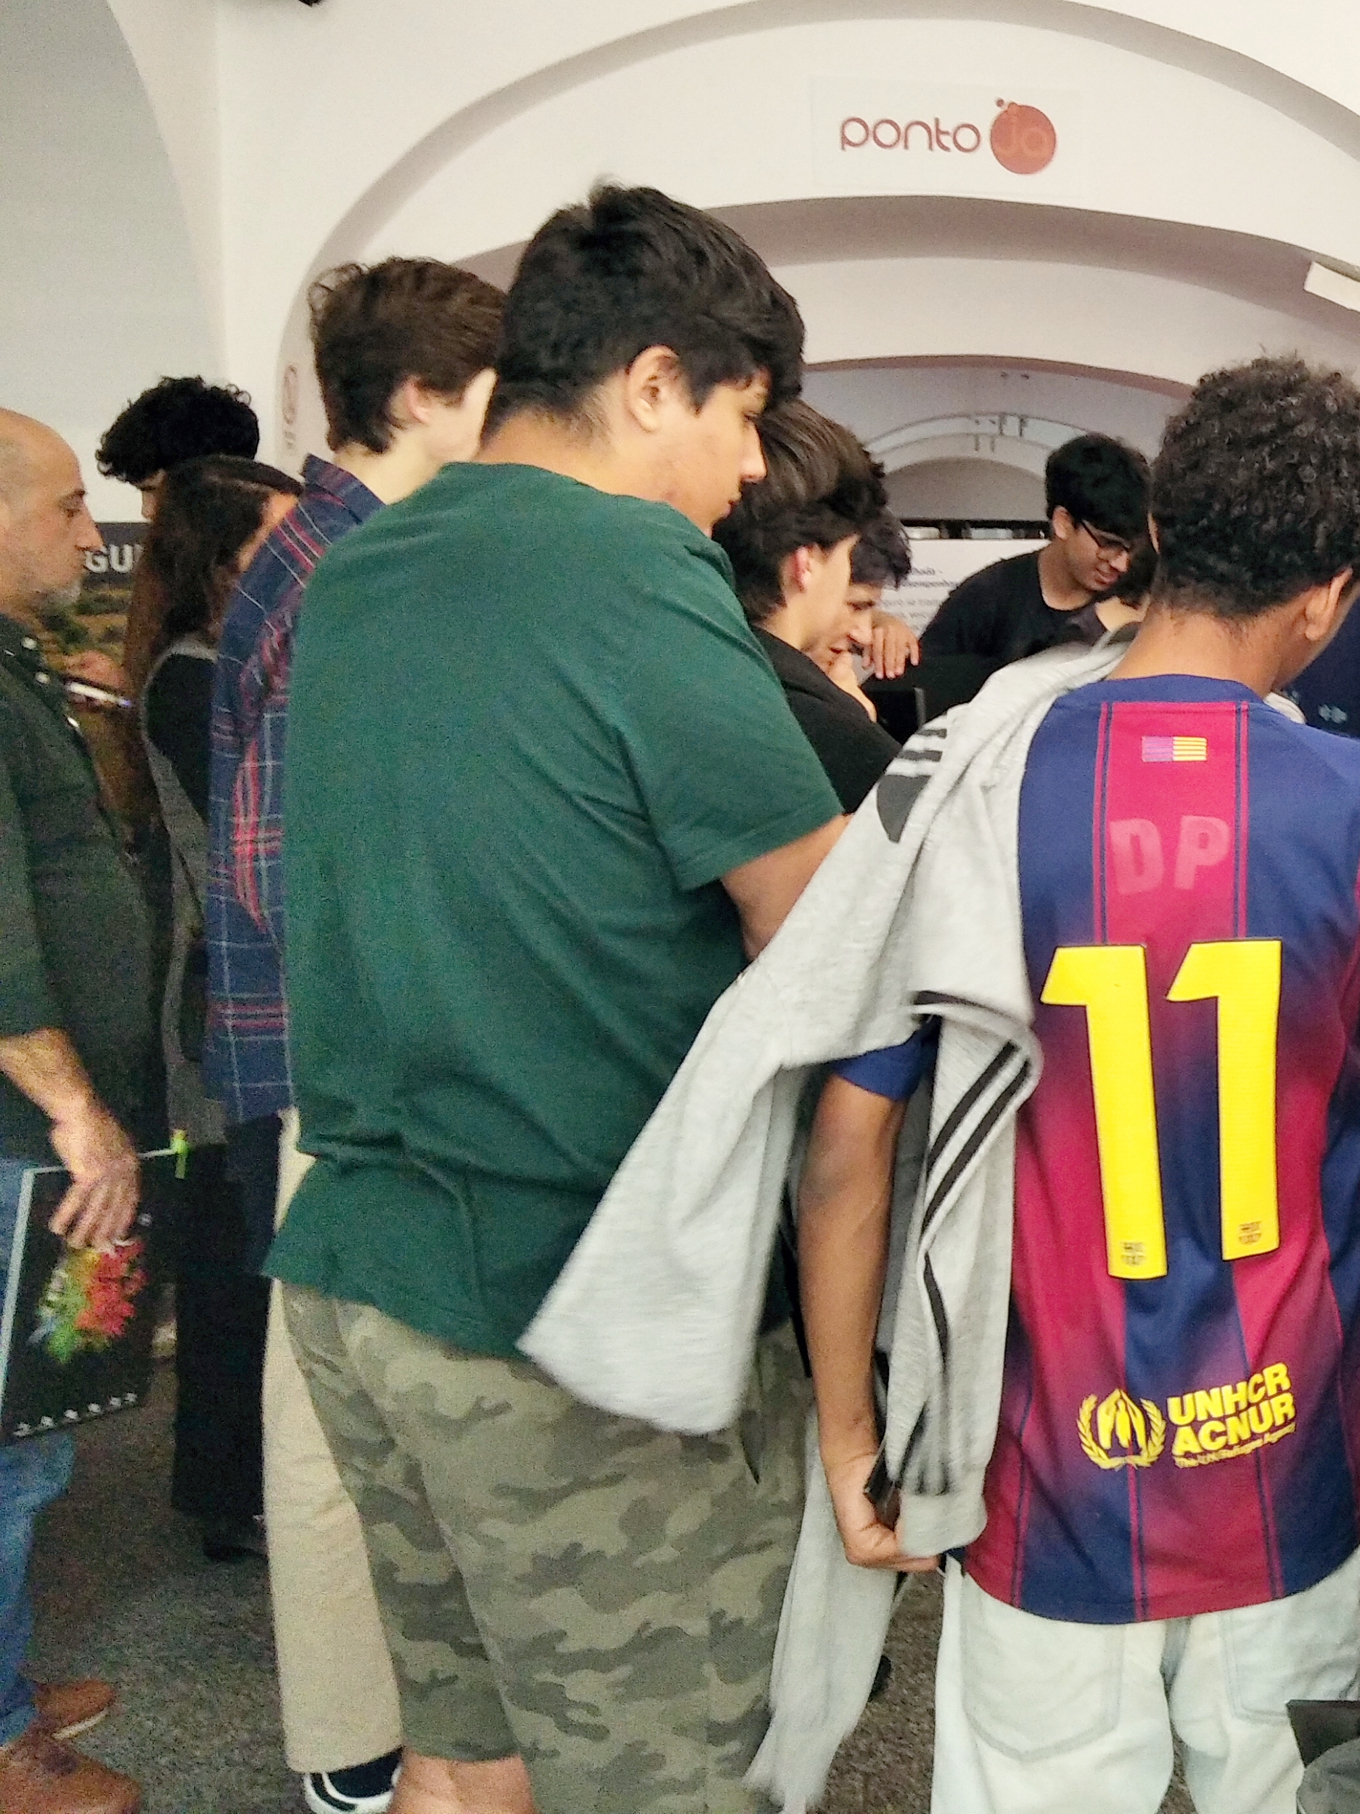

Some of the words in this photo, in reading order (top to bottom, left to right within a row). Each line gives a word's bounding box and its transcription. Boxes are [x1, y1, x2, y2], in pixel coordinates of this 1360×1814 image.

[841, 116, 980, 153] ponto
[1110, 814, 1232, 896] DP
[1040, 938, 1282, 1281] 11
[1167, 1362, 1292, 1427] UNHCR
[1172, 1392, 1296, 1456] ACNUR
